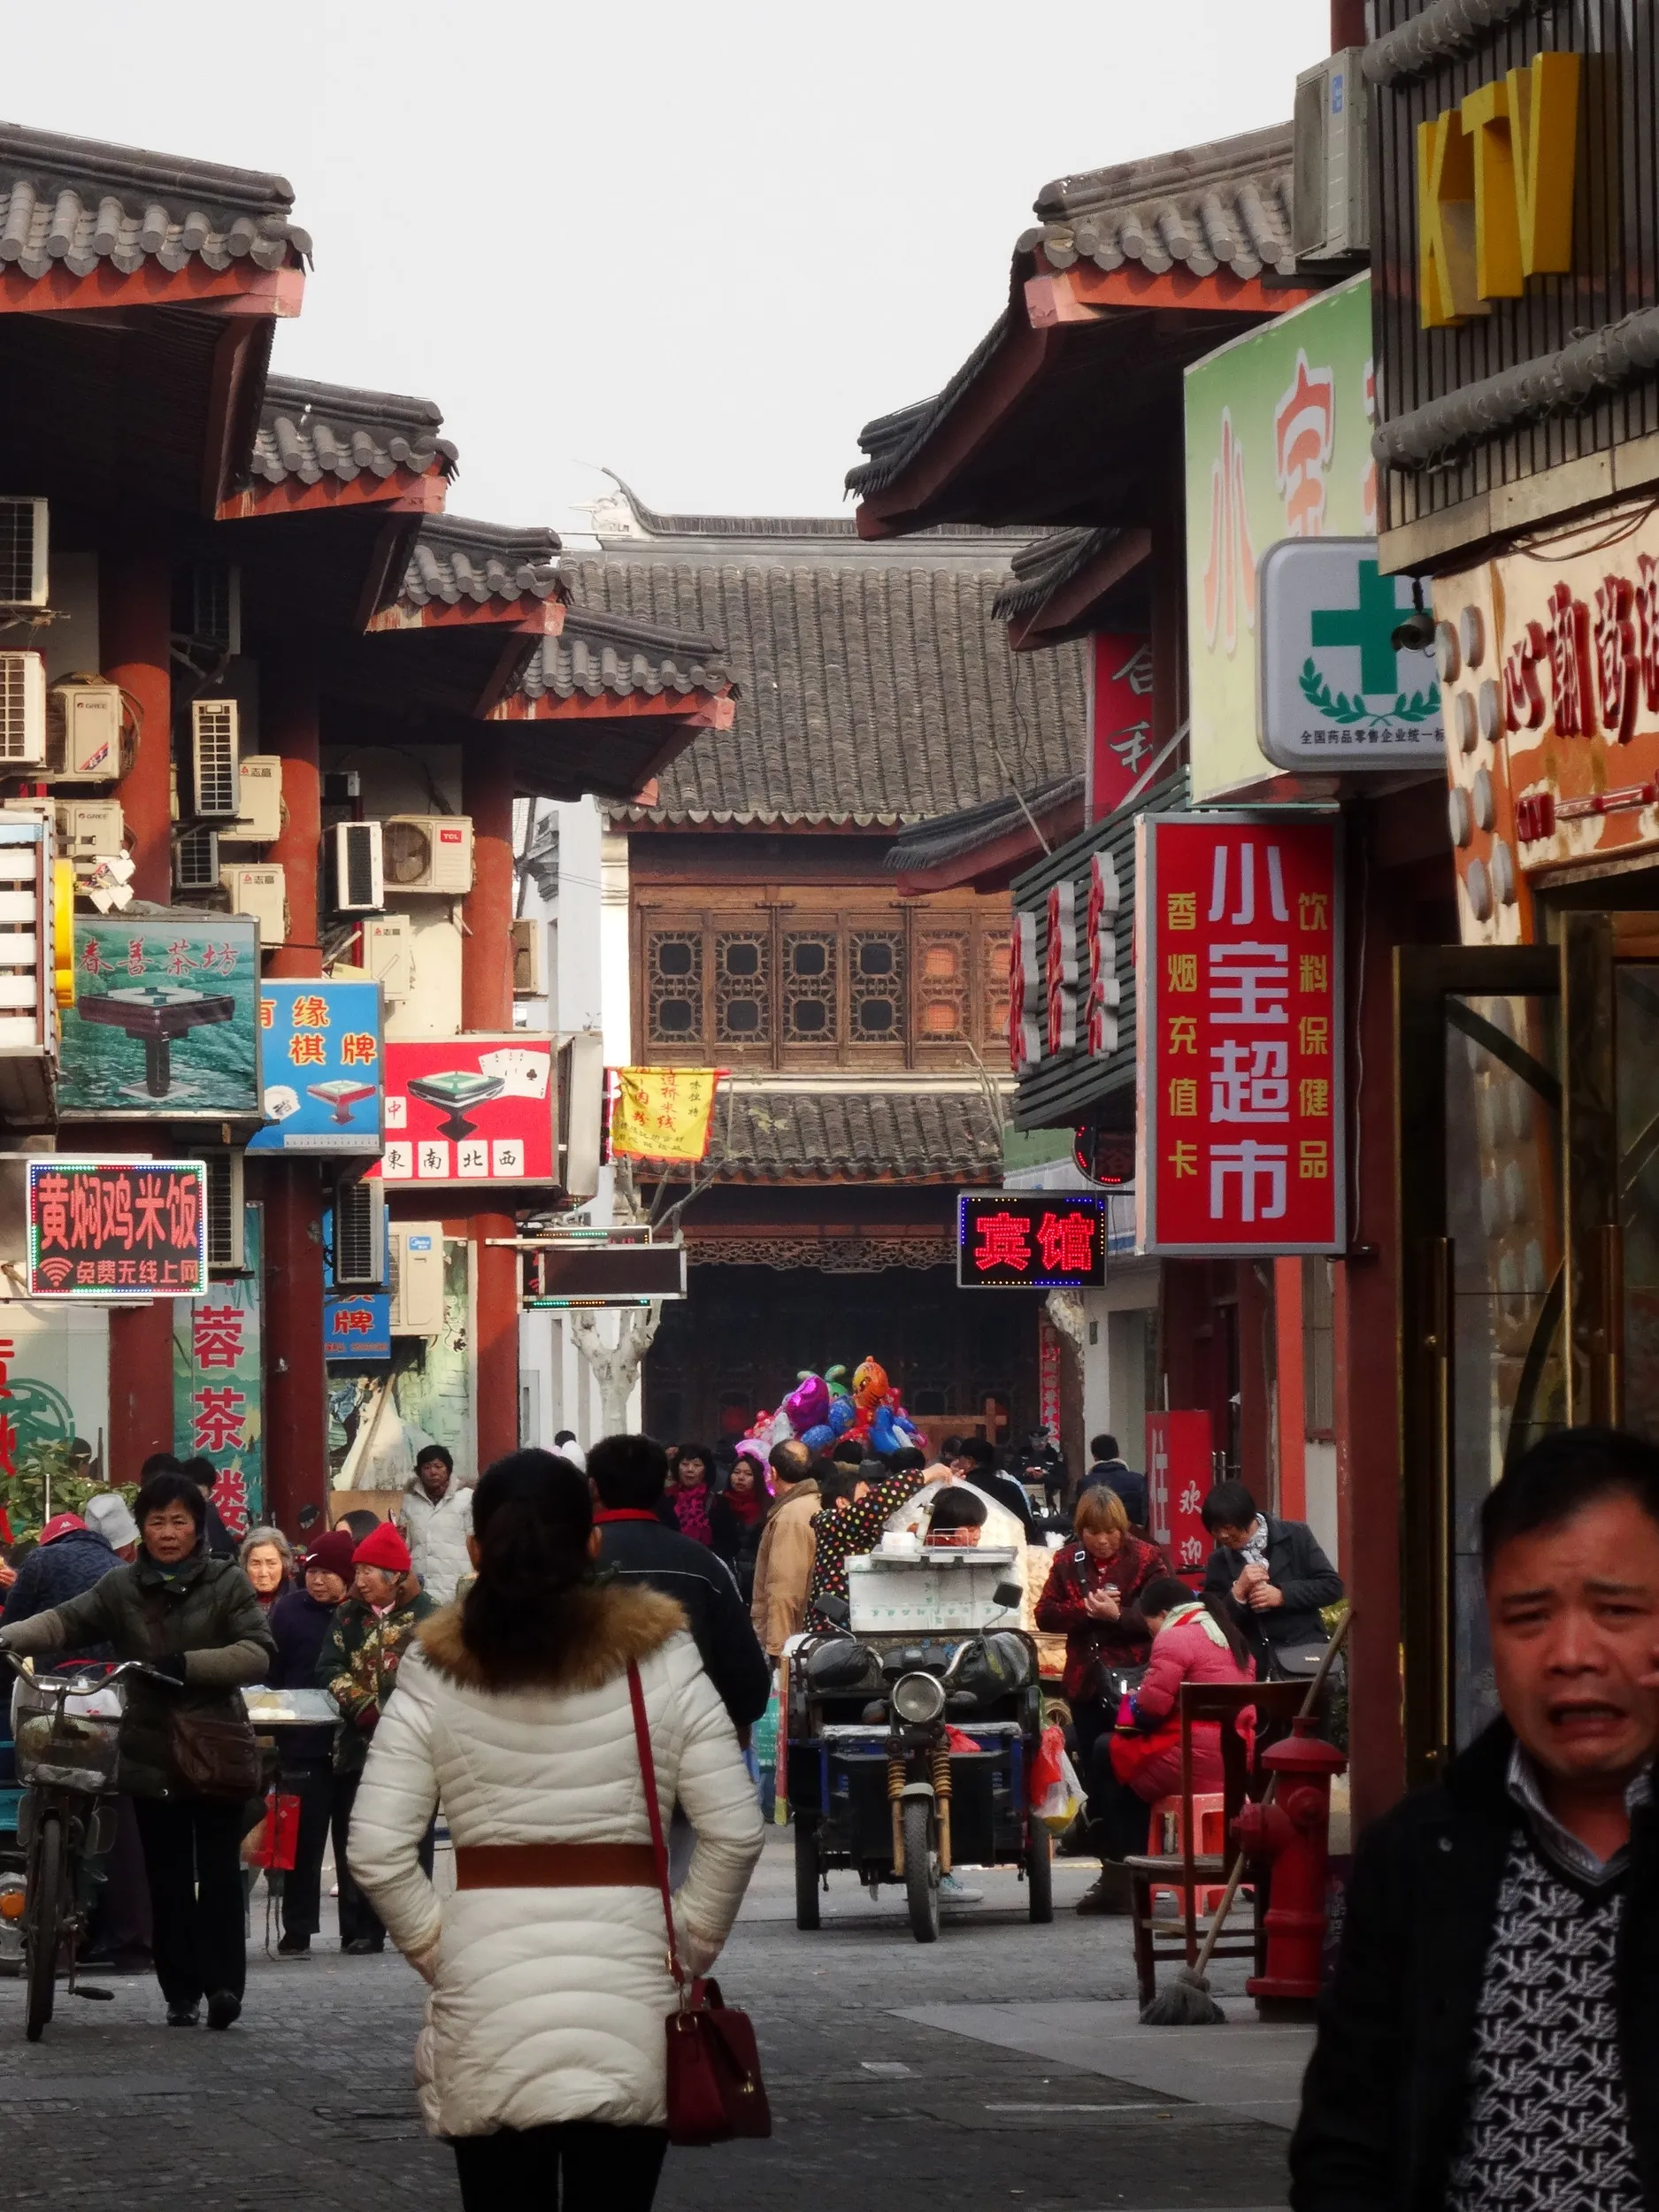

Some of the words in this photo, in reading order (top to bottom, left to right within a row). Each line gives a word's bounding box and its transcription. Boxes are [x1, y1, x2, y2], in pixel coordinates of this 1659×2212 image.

[1417, 51, 1581, 331] KTV
[77, 935, 239, 978] 春善茶坊
[288, 1033, 379, 1065] 棋牌
[1166, 891, 1198, 1179] 香烟充值卡
[1208, 842, 1290, 1224] 小宝超市
[1297, 891, 1329, 1179] 饮料保健品
[388, 1100, 402, 1121] 中
[38, 1172, 199, 1250] 黄焖鸡米饭
[975, 1211, 1095, 1271] 宾馆
[76, 1258, 199, 1284] 免费无线上网
